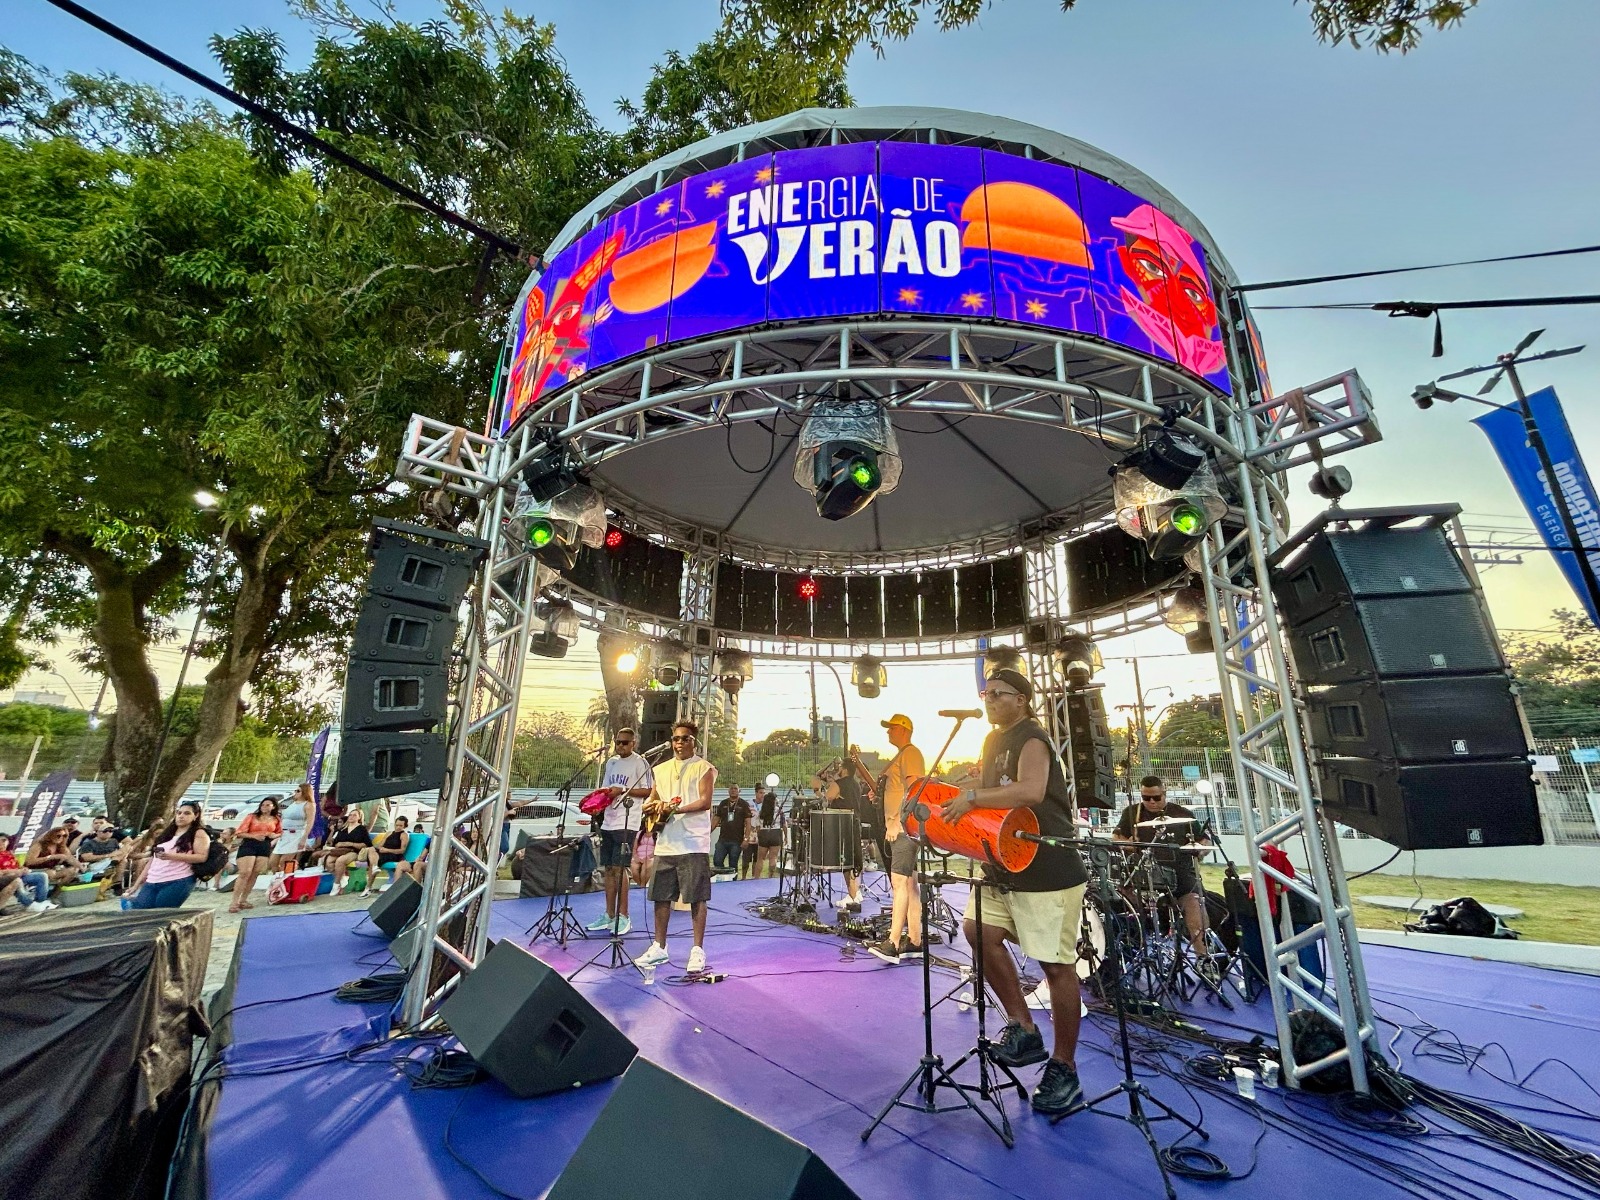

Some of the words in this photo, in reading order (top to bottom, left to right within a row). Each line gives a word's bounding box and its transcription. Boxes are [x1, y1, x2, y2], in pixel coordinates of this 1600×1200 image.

[727, 174, 884, 235] ENERGIA
[912, 177, 946, 213] DE
[730, 207, 962, 285] VERÃO
[1536, 504, 1570, 554] ENERGI
